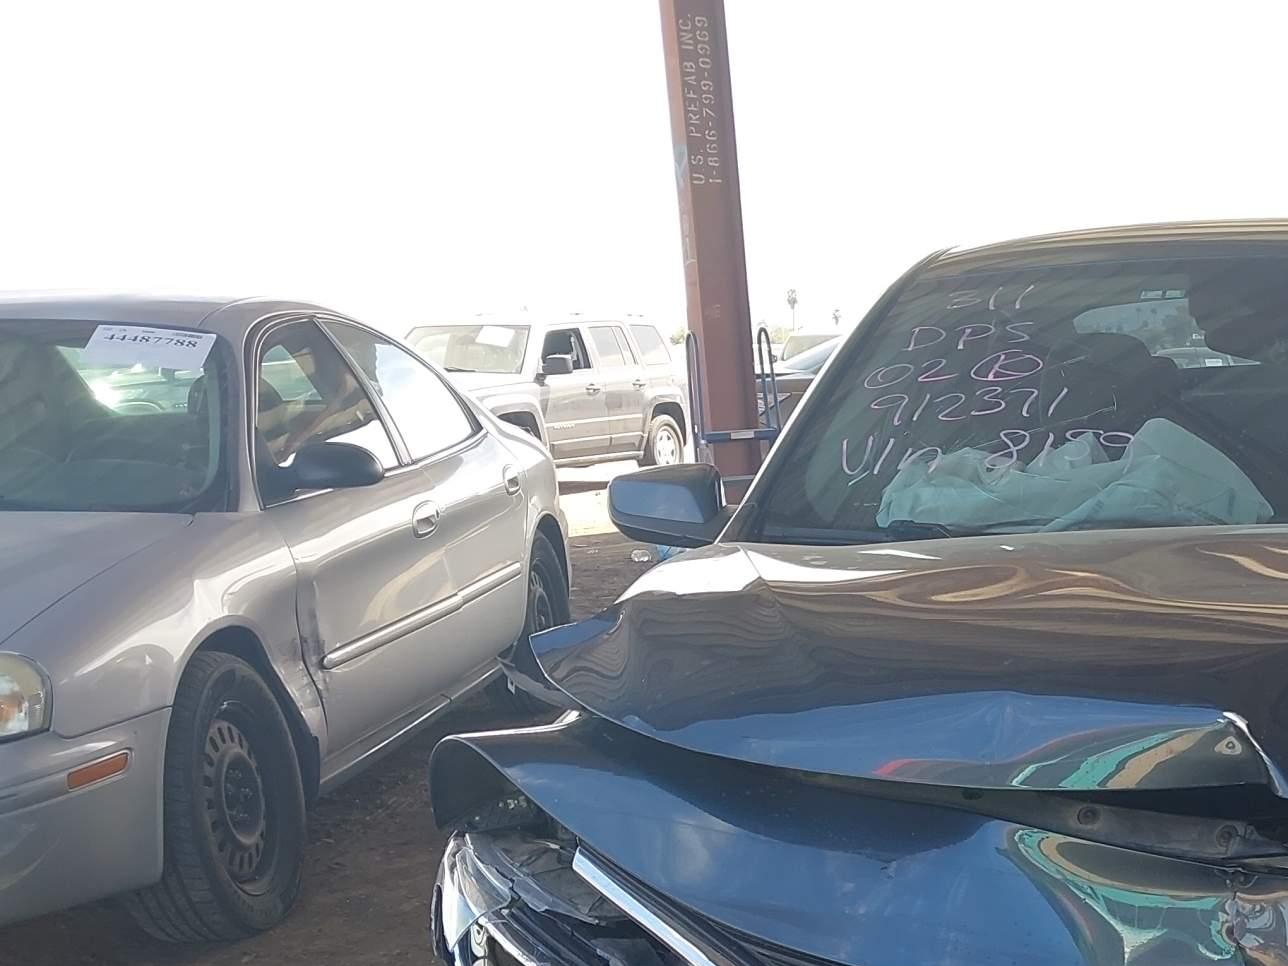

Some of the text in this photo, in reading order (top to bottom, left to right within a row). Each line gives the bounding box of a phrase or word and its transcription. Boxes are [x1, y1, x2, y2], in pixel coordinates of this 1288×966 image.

[678, 13, 705, 185] U.S. PREFAB INC.
[695, 16, 722, 184] 1-866-799-0969
[104, 333, 198, 348] 44487788
[905, 322, 1034, 351] DPS
[870, 386, 1068, 427] 912371
